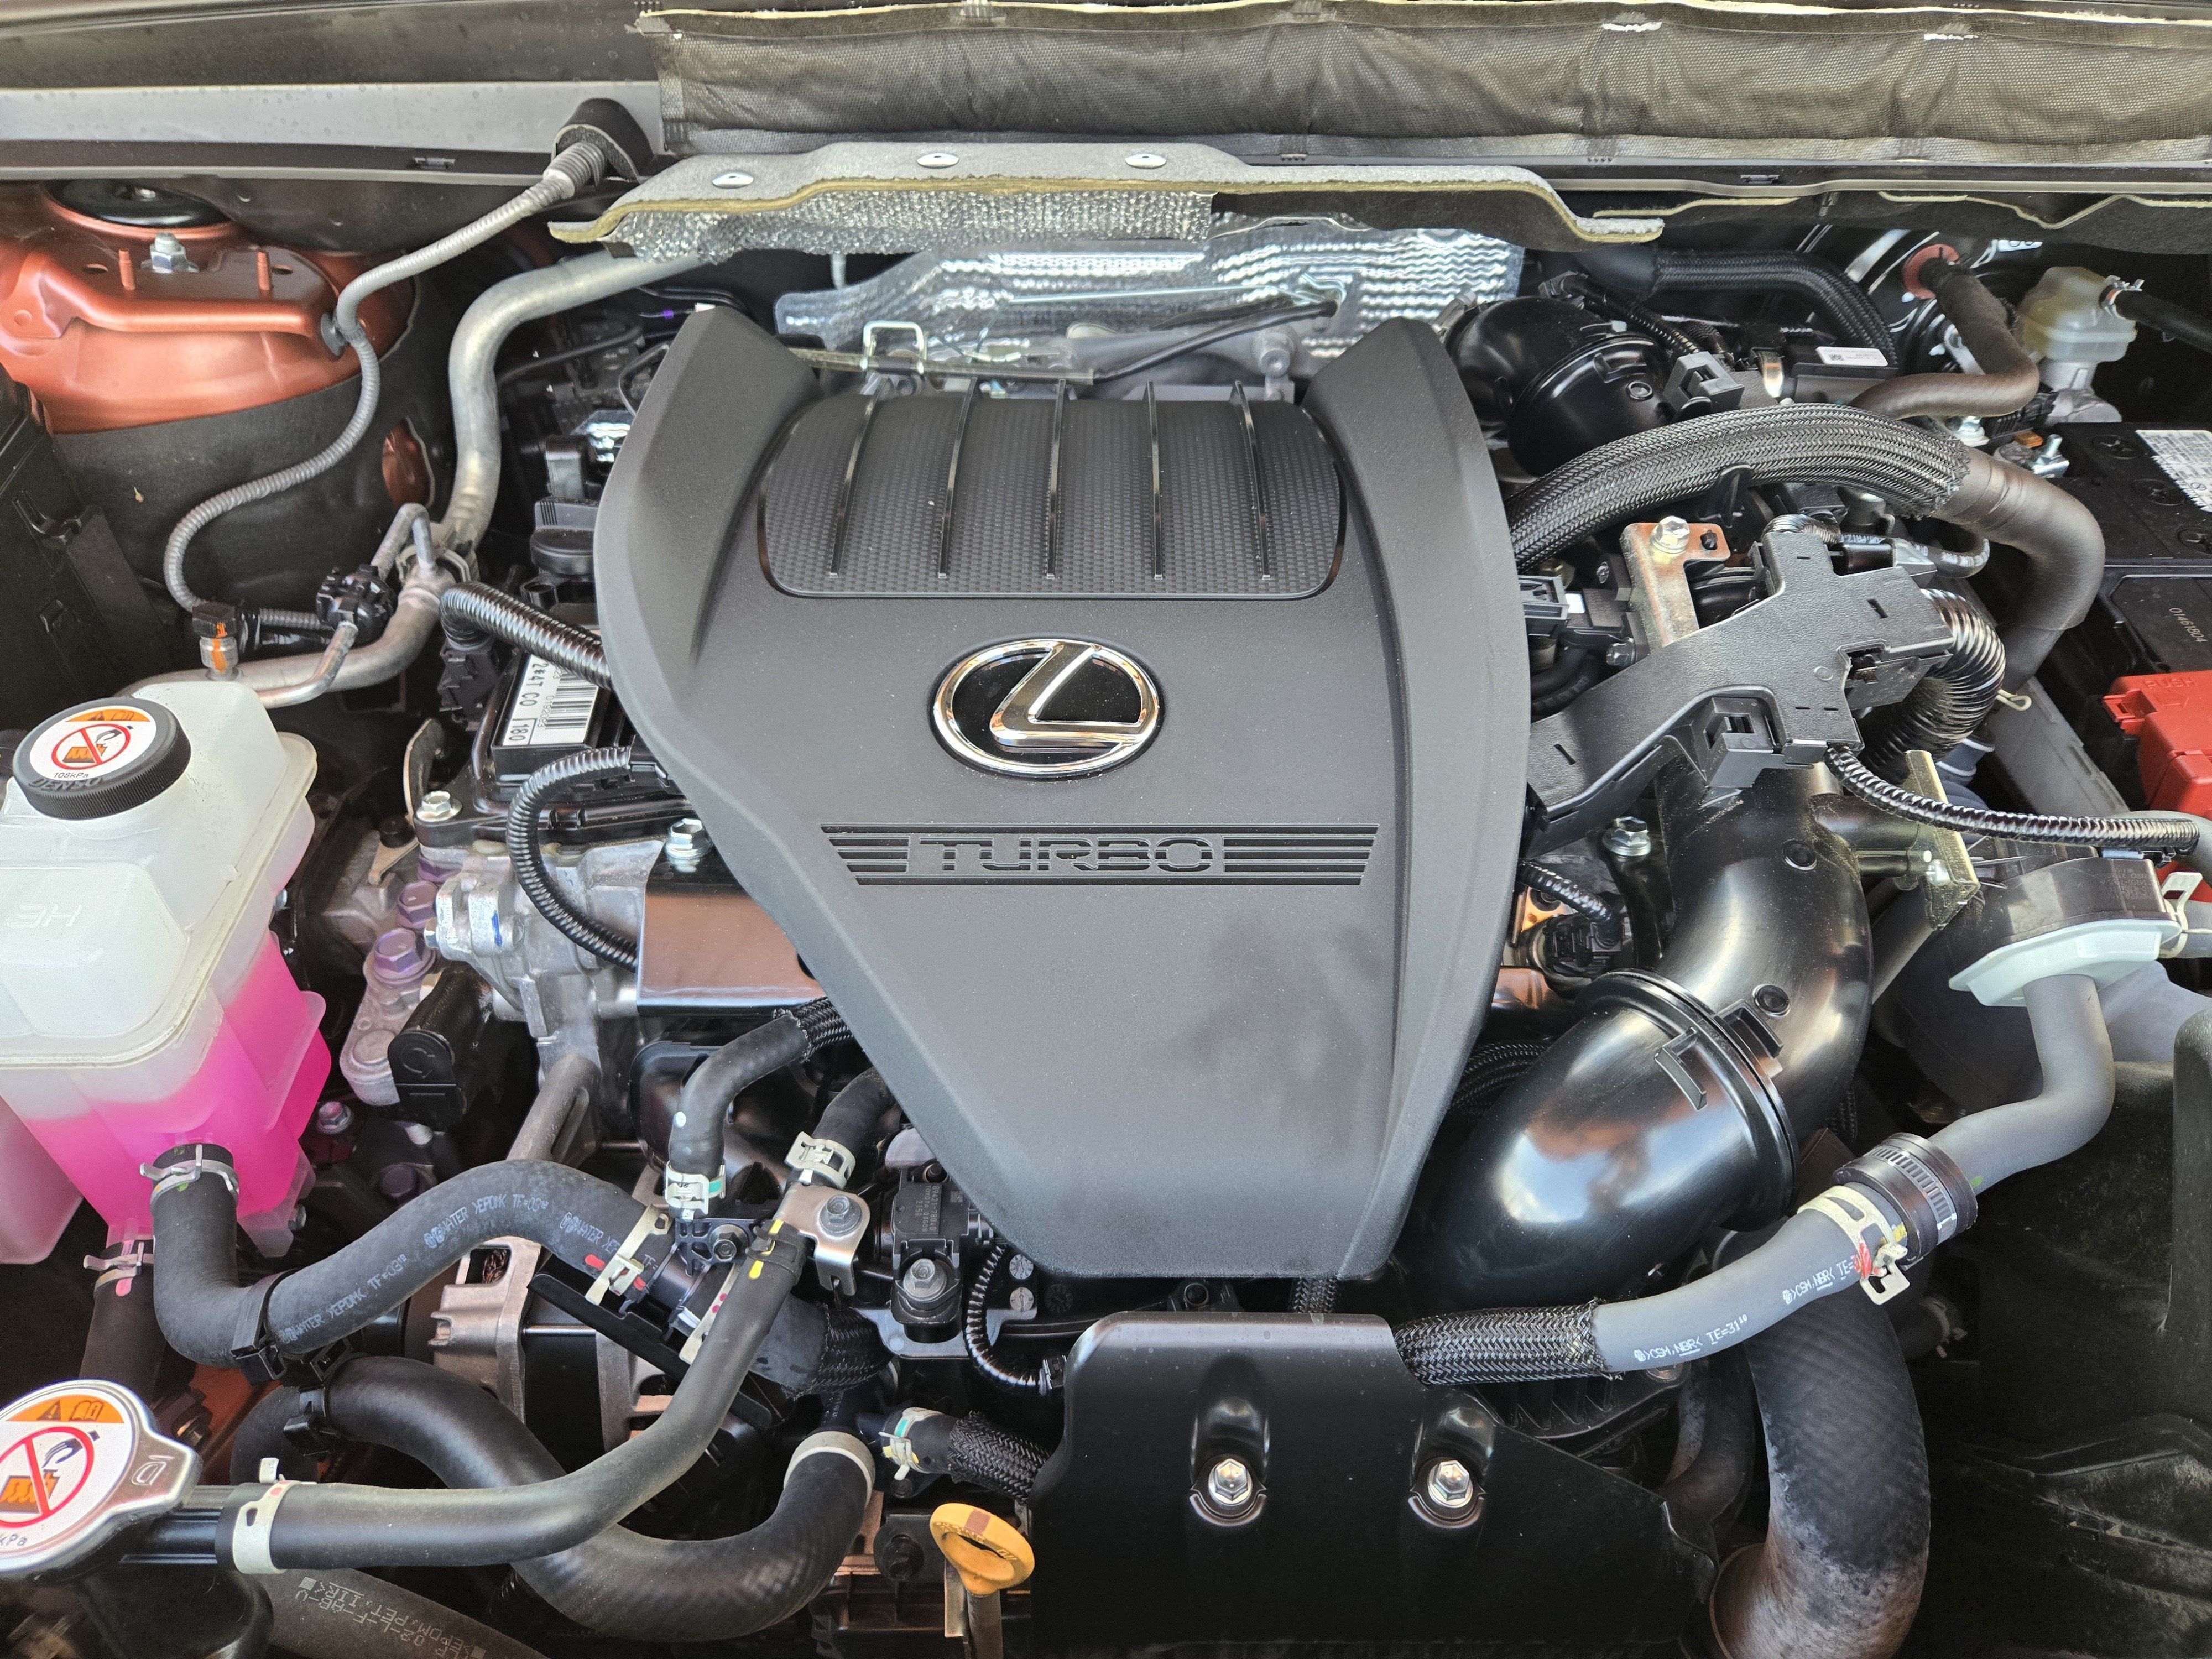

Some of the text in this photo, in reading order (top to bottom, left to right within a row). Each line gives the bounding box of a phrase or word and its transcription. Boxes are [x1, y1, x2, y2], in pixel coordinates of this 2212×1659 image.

[2142, 678, 2193, 689] PUSH
[508, 724, 530, 741] 180
[28, 776, 103, 791] DENSO
[919, 837, 1214, 872] TURBO
[924, 1185, 932, 1208] TOYOTA
[440, 1206, 469, 1232] WATER
[578, 1219, 604, 1244] WATER
